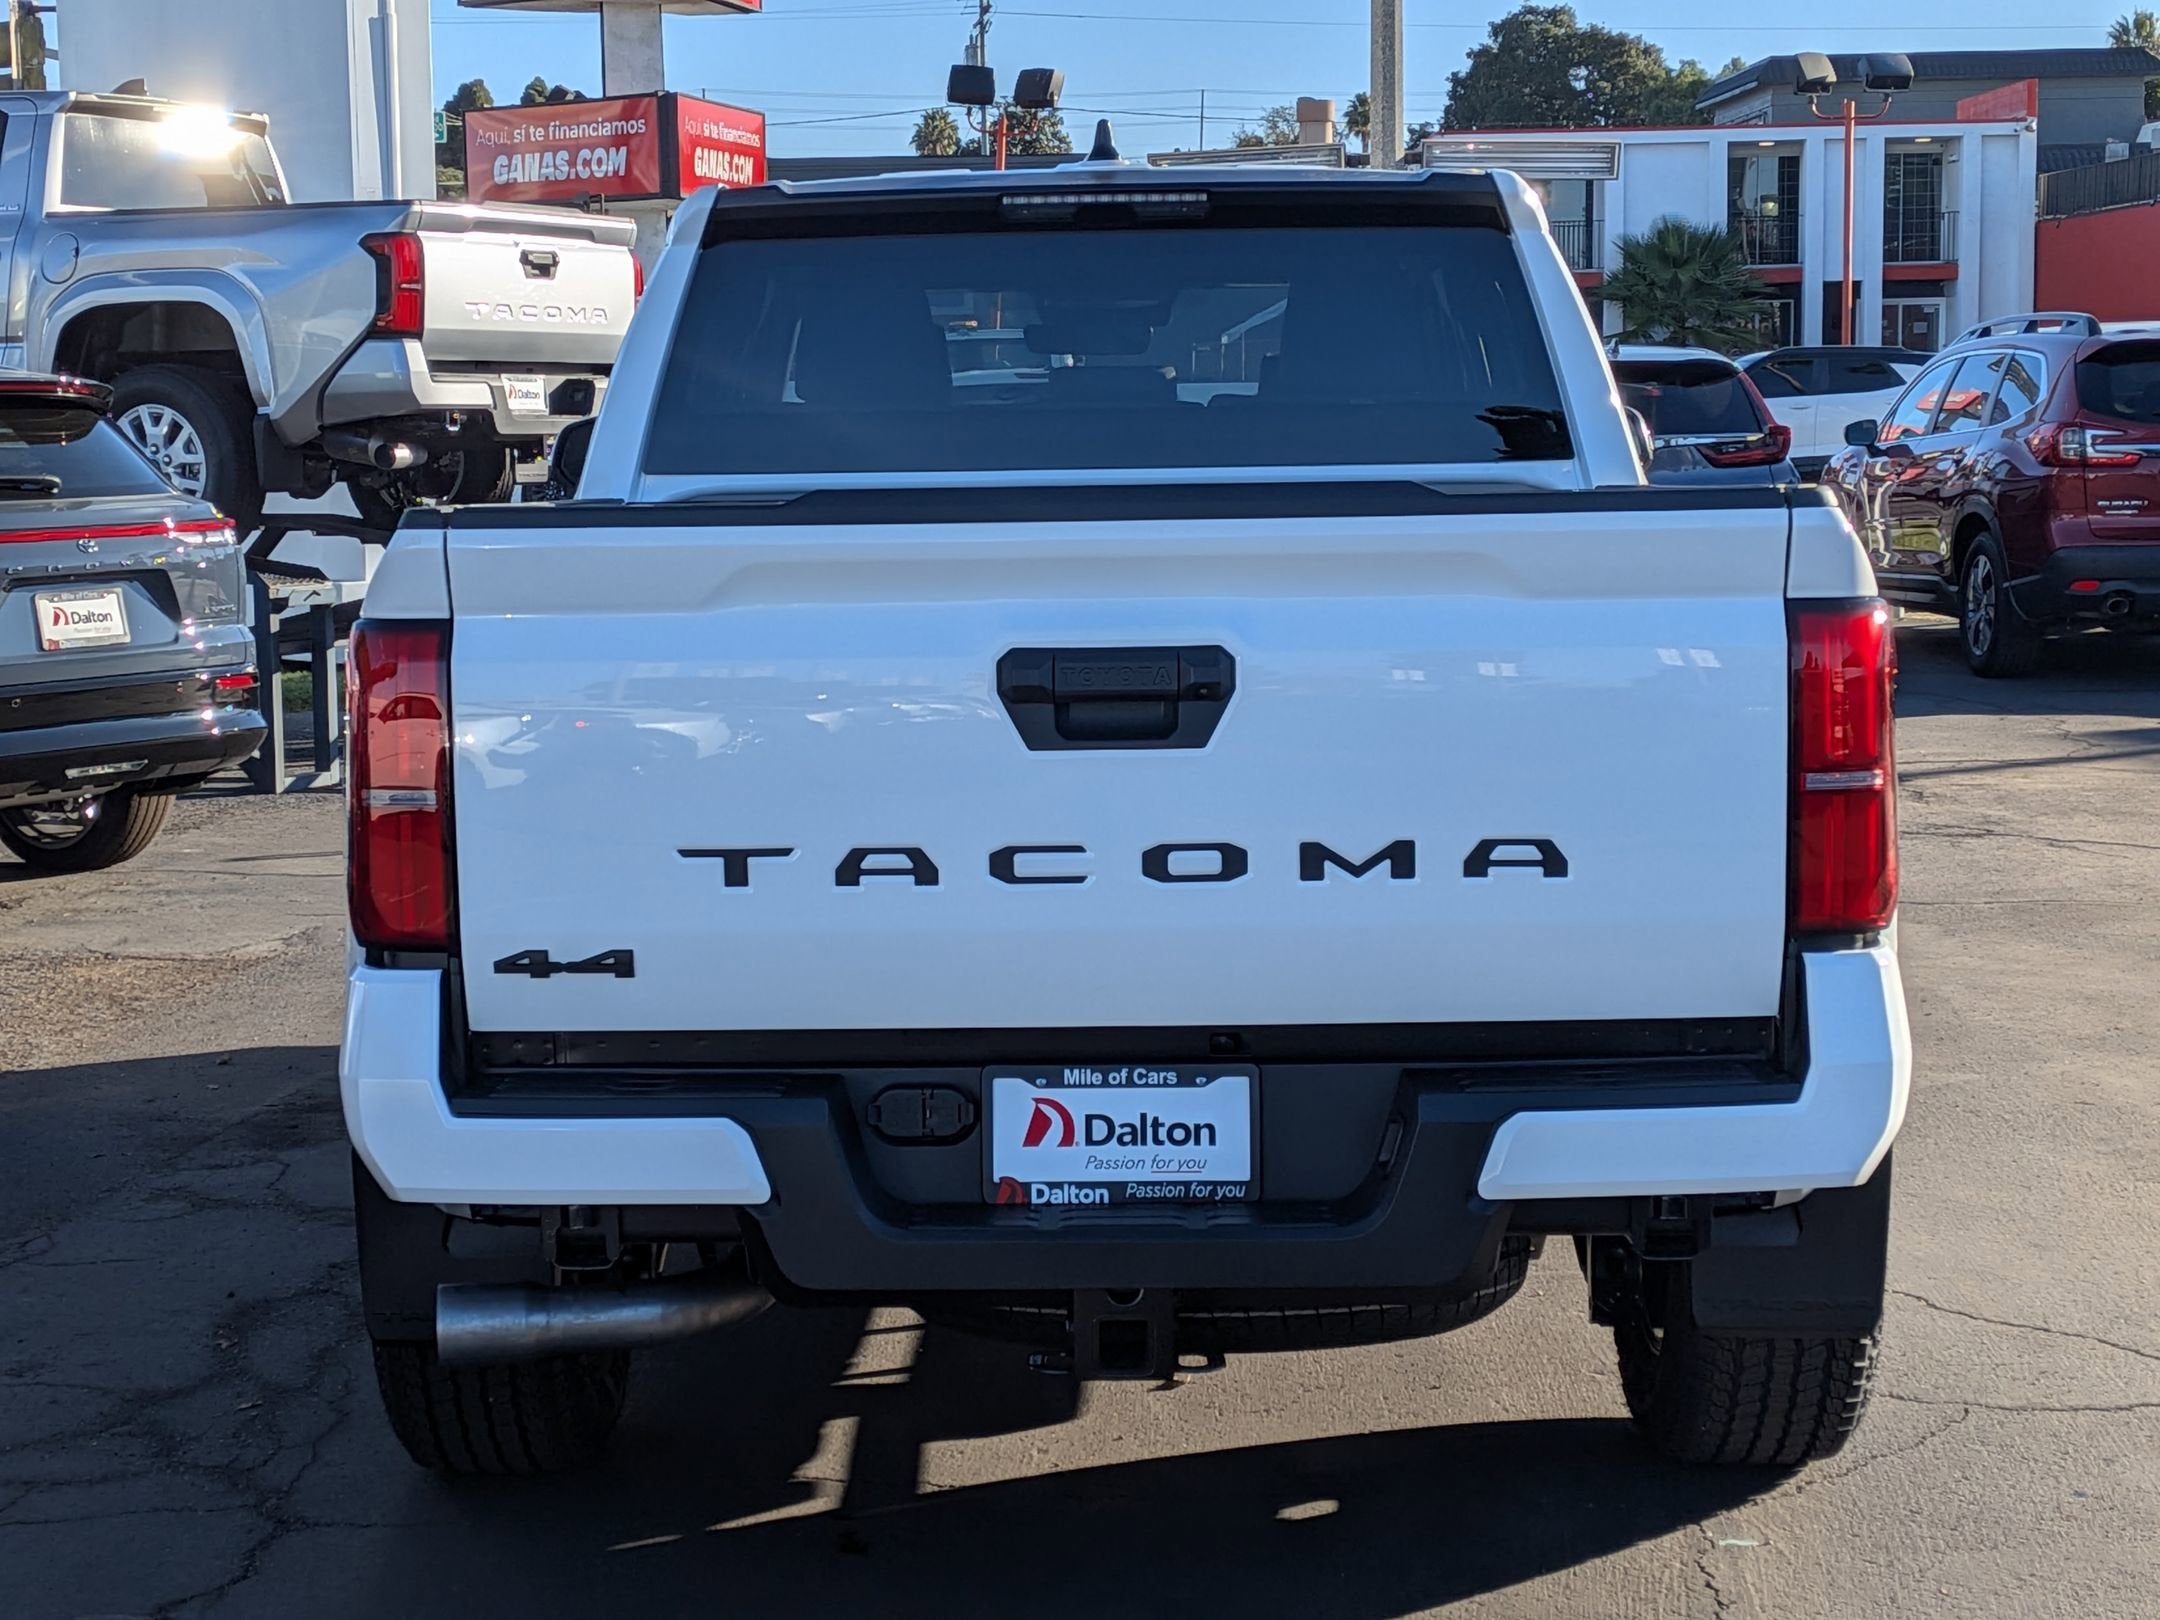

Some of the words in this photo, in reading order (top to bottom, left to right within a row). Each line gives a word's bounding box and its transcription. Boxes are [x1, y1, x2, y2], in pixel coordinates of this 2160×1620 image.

[529, 126, 544, 142] te
[549, 118, 646, 140] financiamos
[493, 146, 627, 185] GANAS.COM
[694, 146, 753, 185] GANAS.COM
[465, 302, 608, 324] TACOMA
[70, 610, 113, 625] Dalton
[1060, 666, 1173, 687] TOYOTA
[675, 838, 1570, 888] TACOMA
[1063, 1068, 1102, 1085] Mile
[1108, 1068, 1128, 1085] of
[1133, 1068, 1177, 1085] Cars
[1084, 1112, 1216, 1147] Dalton
[1085, 1155, 1145, 1170] Passion
[1150, 1153, 1174, 1170] for
[1177, 1158, 1207, 1172] you
[1031, 1183, 1109, 1205] Dalton
[1125, 1183, 1187, 1198] Passion
[1189, 1183, 1213, 1198] for
[1217, 1186, 1246, 1200] you
